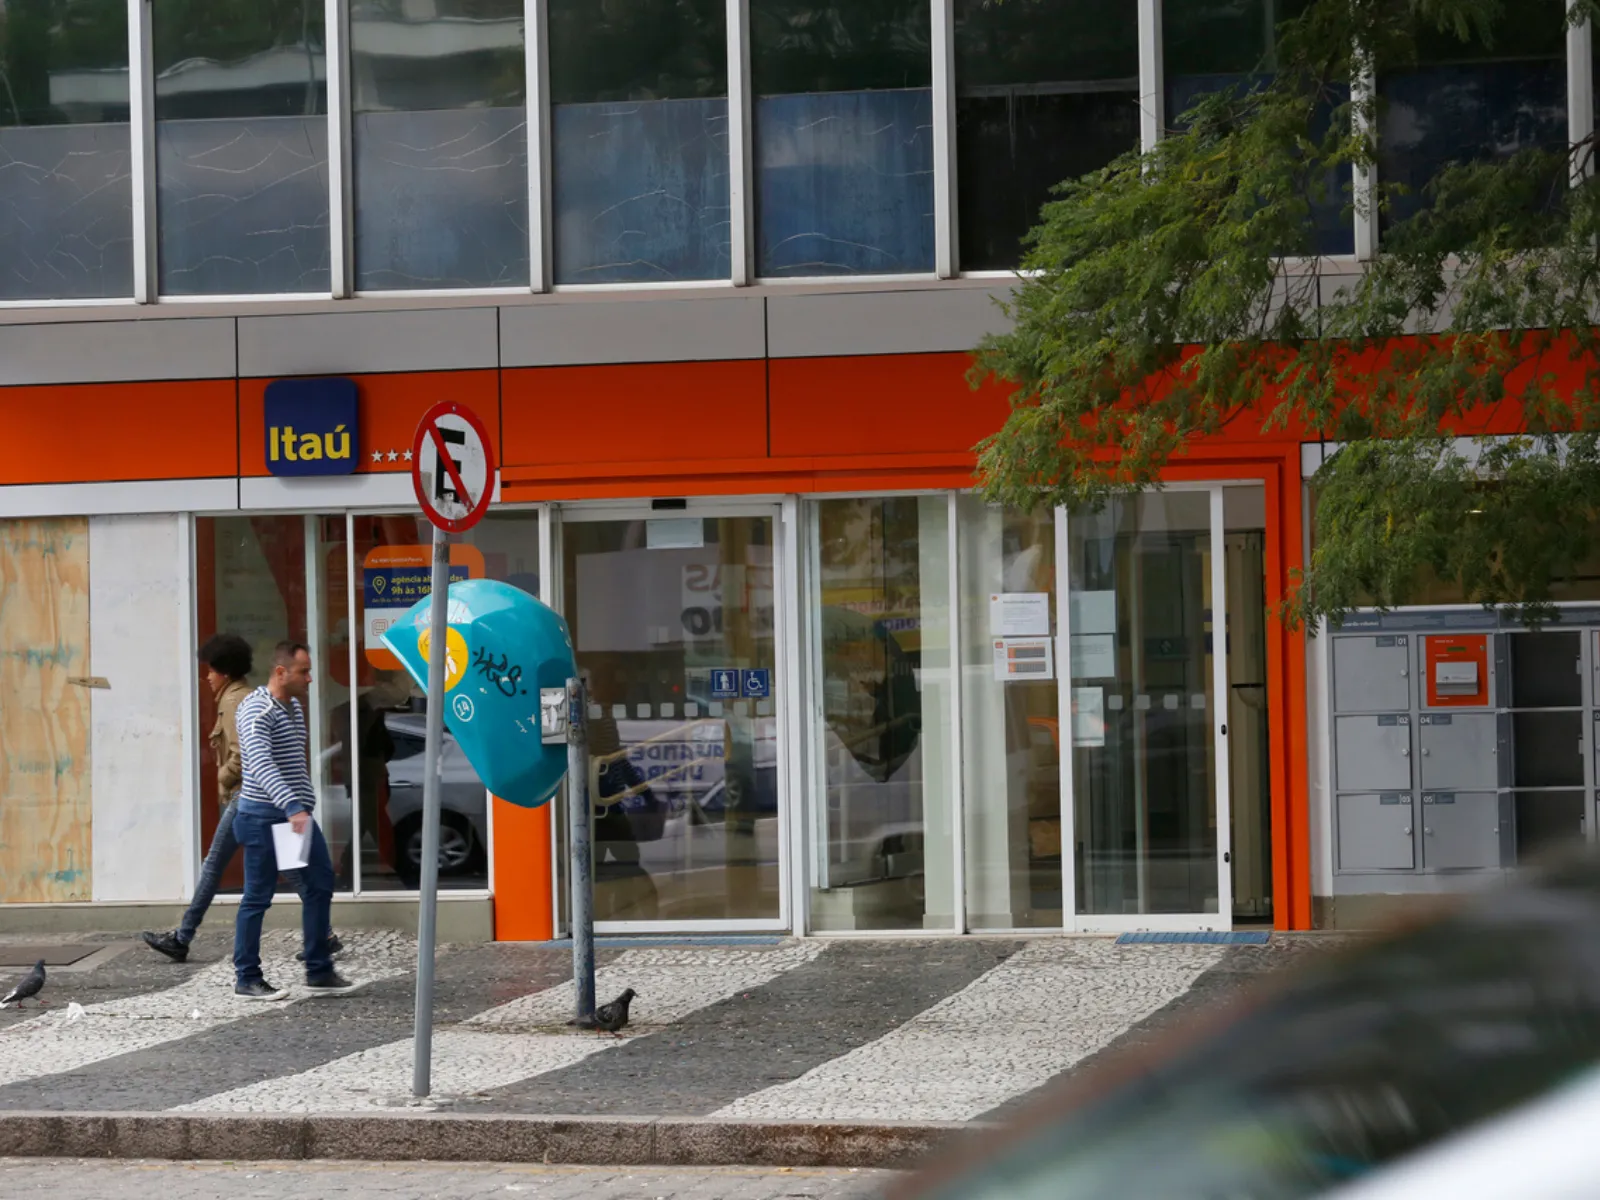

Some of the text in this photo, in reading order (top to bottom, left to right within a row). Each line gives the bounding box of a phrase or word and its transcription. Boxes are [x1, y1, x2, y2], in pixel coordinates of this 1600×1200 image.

[269, 424, 351, 462] Itaú
[436, 427, 466, 503] E
[391, 575, 421, 585] agência
[391, 585, 403, 595] 9h
[1397, 637, 1406, 645] 01
[456, 699, 471, 717] 14
[1423, 795, 1433, 803] 05
